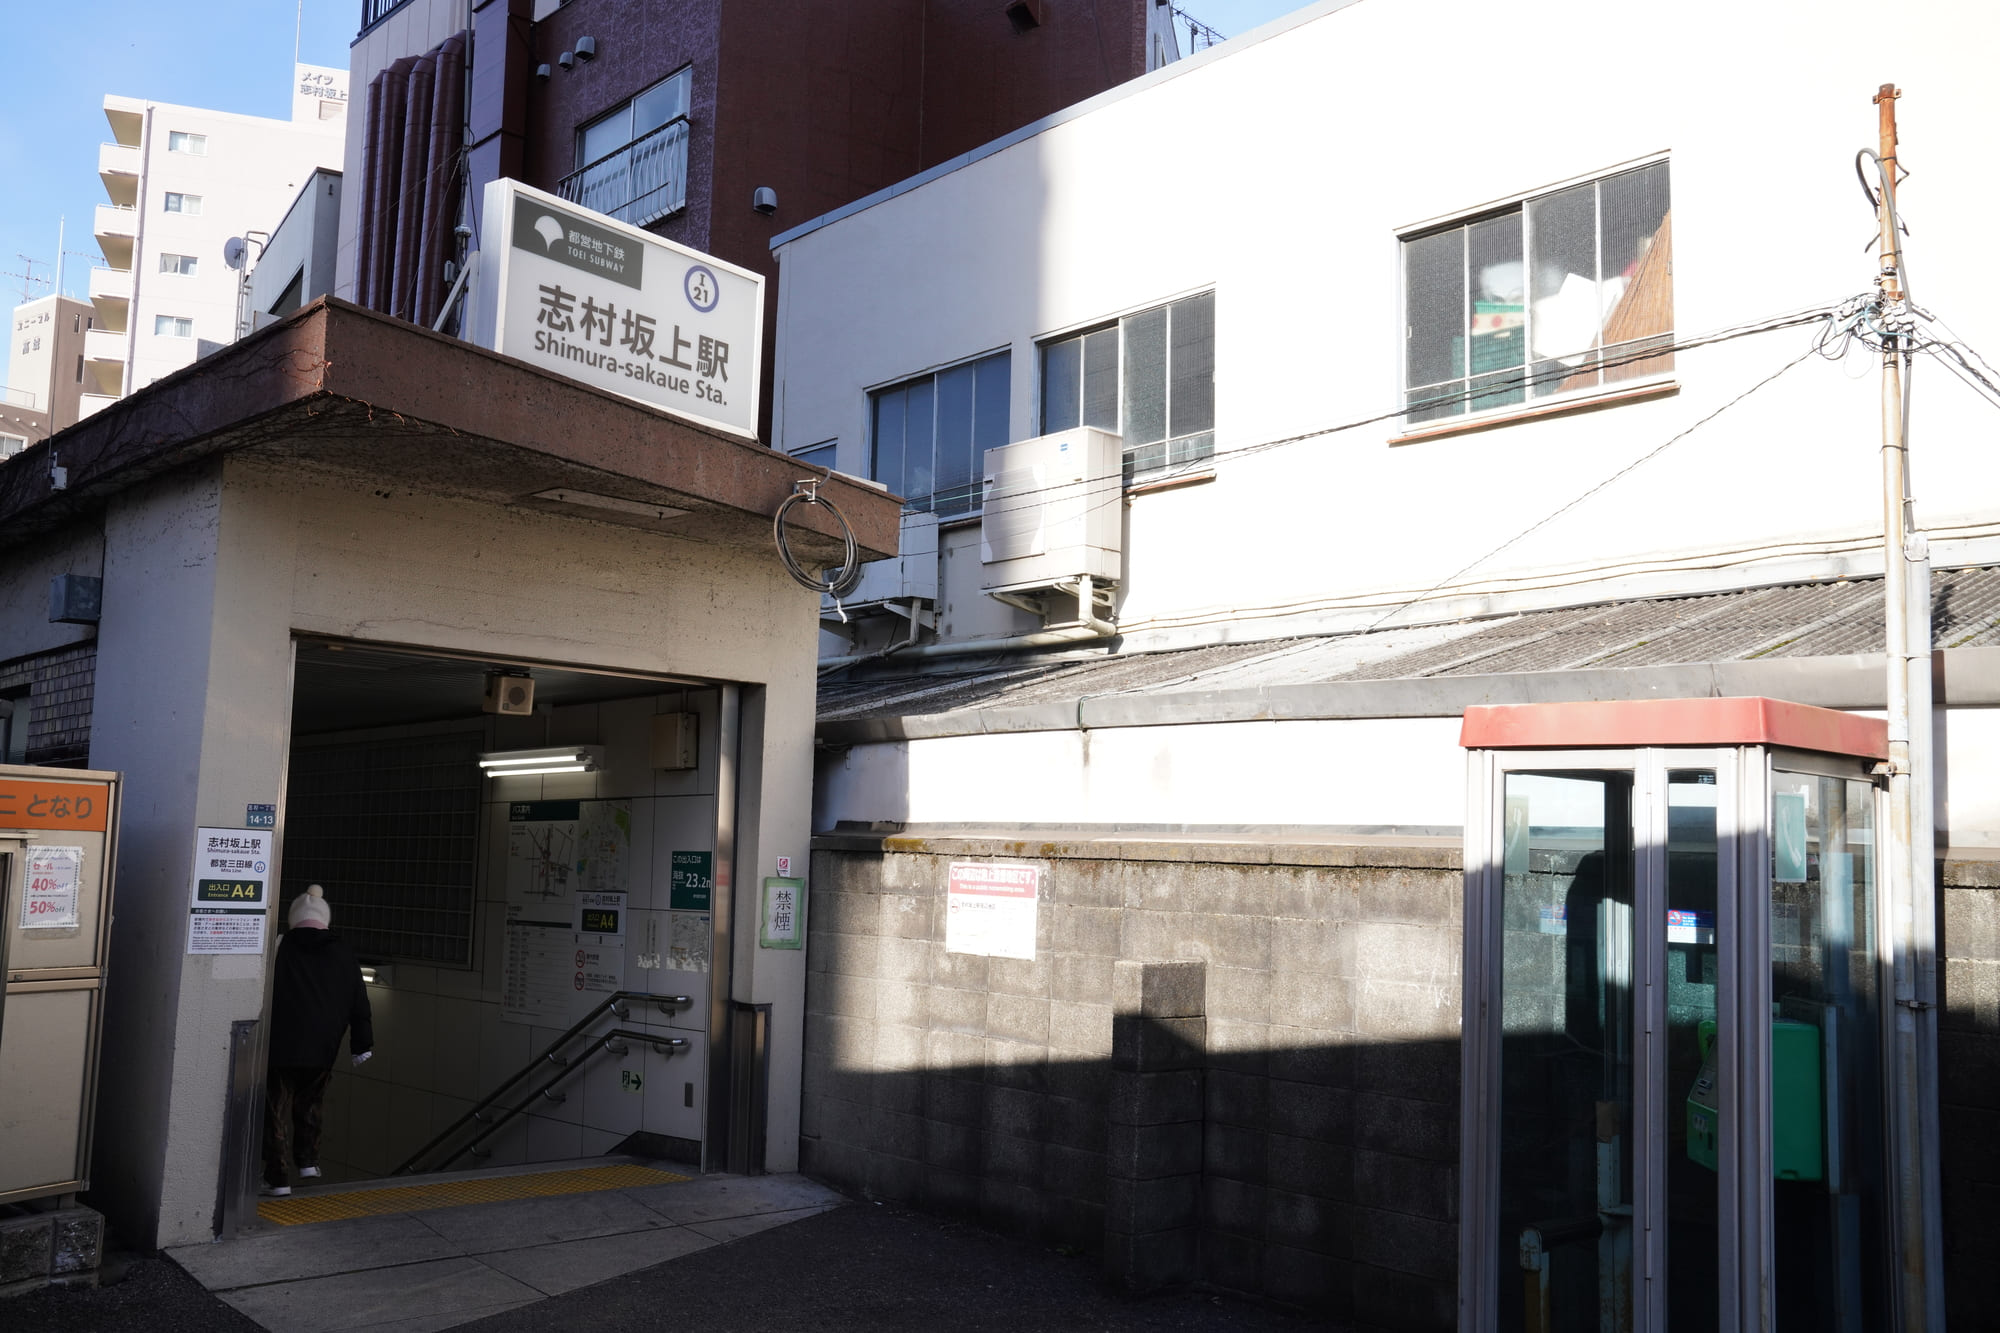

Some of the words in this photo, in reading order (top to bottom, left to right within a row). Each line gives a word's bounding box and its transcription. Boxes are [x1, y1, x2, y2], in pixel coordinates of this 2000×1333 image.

[302, 72, 333, 85] メイツ
[300, 84, 348, 101] 志村坂上
[568, 230, 625, 262] 都営地下鉄
[567, 246, 587, 260] TOEI
[590, 249, 625, 273] SUBWAY
[699, 274, 705, 286] I
[693, 287, 708, 303] 21
[537, 284, 729, 383] 志村坂上駅
[534, 330, 690, 394] Shimura-sakaue
[695, 380, 728, 406] Sta.
[27, 794, 92, 819] となり
[250, 815, 273, 825] 14-13
[207, 847, 250, 855] Shimura-sakaue
[208, 837, 261, 849] 志村坂上駅
[210, 859, 253, 868] 都営三田線
[672, 855, 702, 864] この出入口は
[231, 884, 255, 898] A4
[774, 890, 792, 931] 禁煙
[600, 913, 615, 929] A4
